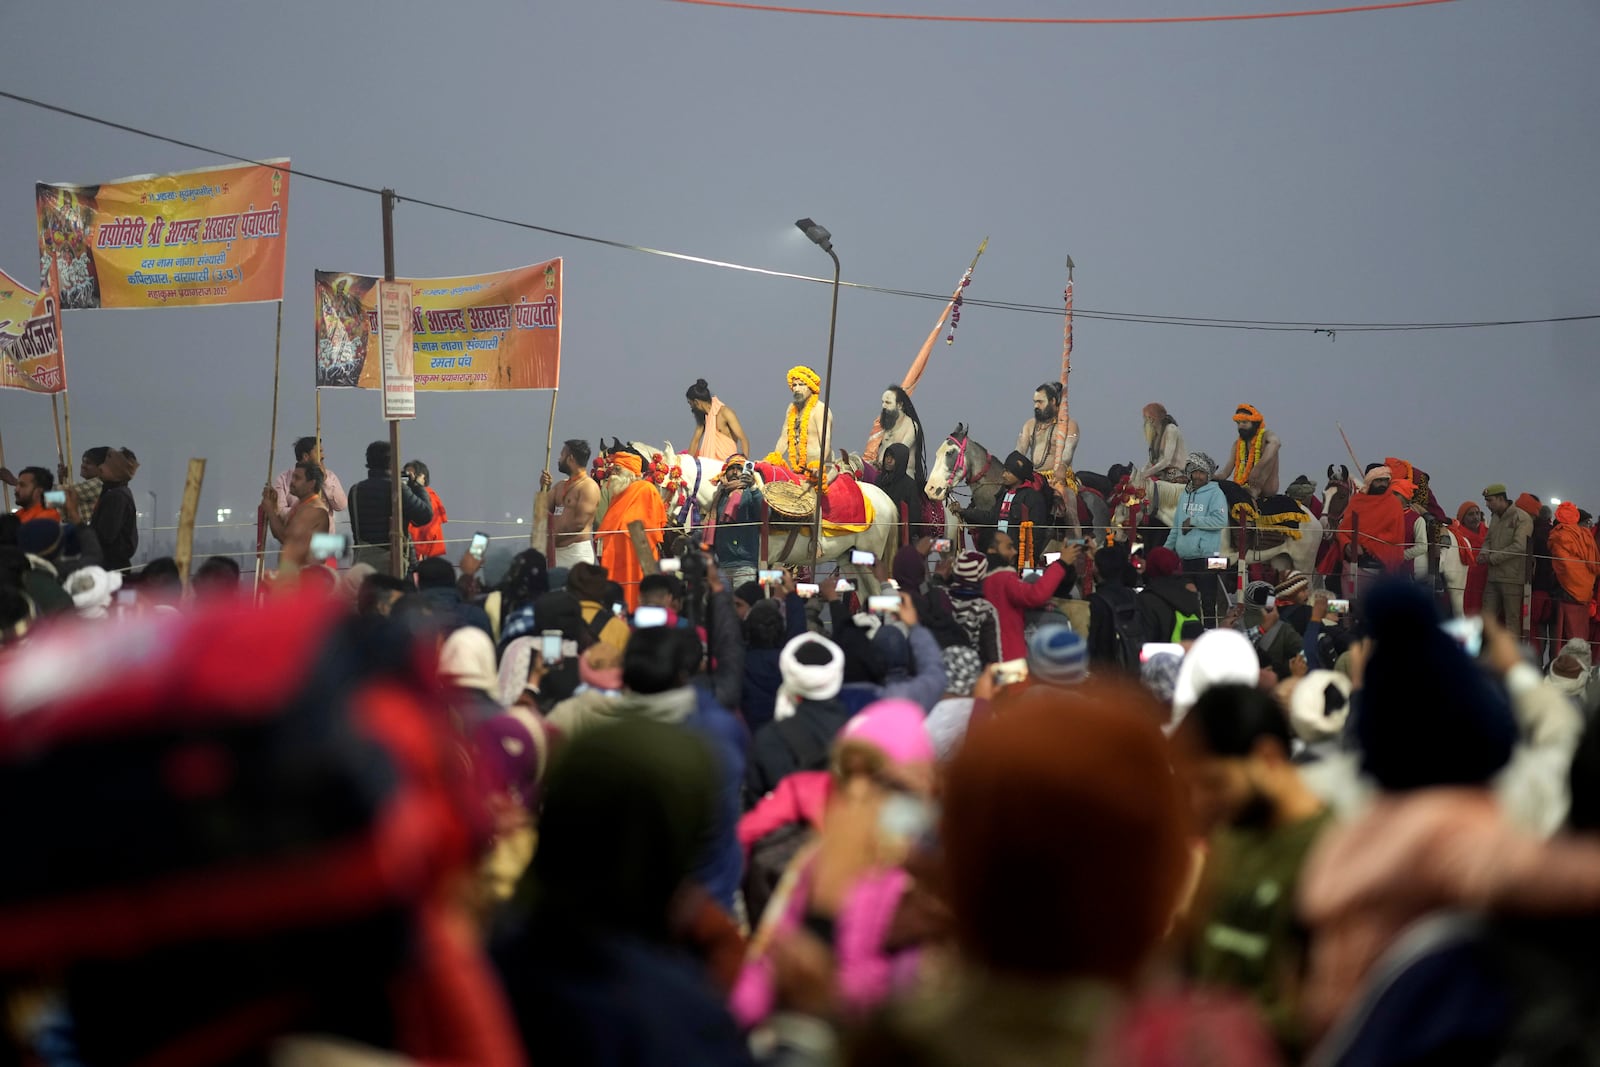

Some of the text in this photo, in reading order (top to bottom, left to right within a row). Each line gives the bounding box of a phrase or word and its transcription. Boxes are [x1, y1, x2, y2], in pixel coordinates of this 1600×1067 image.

[97, 216, 147, 248] तपोनिधि
[148, 215, 165, 247] श्री
[165, 218, 201, 246] आनन्द
[241, 201, 280, 238] पंचायती
[141, 258, 154, 268] दस
[157, 257, 174, 268] नाम
[175, 256, 195, 267] नागा
[173, 267, 209, 283] वाराणसी
[213, 286, 228, 296] 2025
[426, 308, 467, 334] आनन्द
[514, 295, 557, 329] पंचायती
[420, 341, 439, 352] नाम
[440, 340, 463, 351] नागा
[431, 353, 473, 369] रमता पंच
[413, 374, 440, 385] हाकुम्भ
[474, 373, 489, 381] 2025
